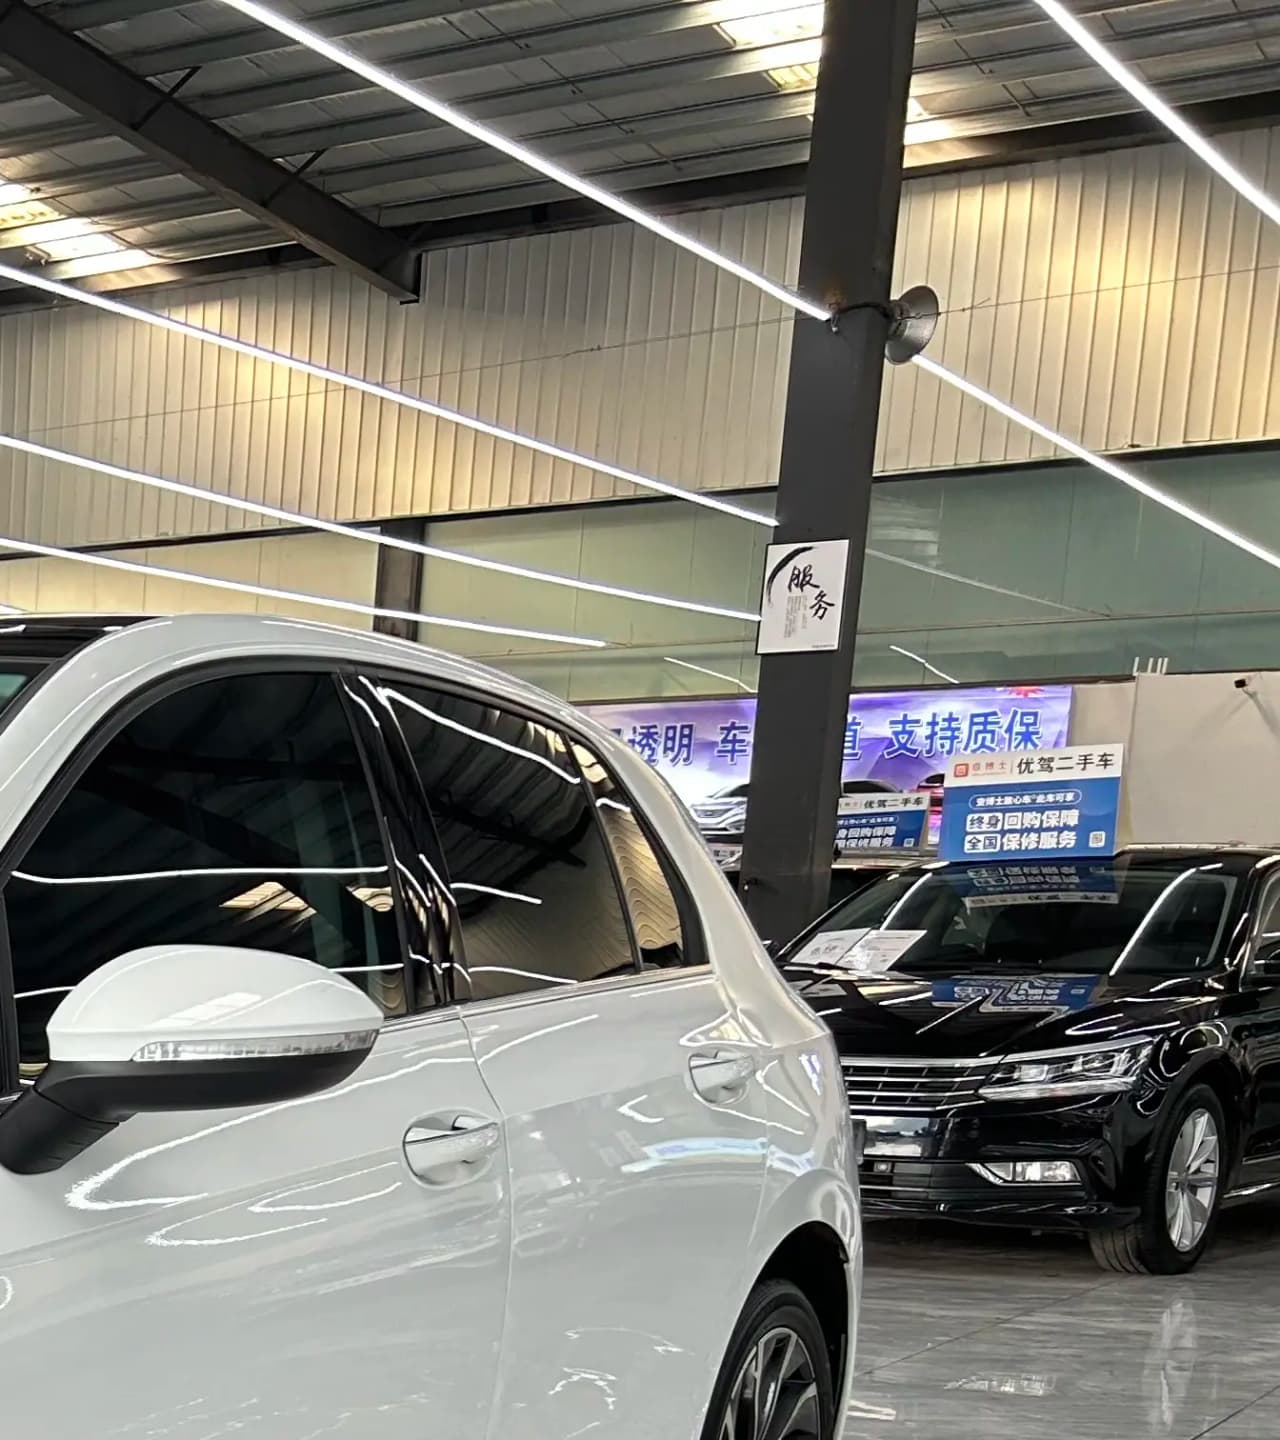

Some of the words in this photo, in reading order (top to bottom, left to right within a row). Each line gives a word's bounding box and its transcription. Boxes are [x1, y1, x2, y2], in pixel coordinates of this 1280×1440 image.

[787, 564, 835, 621] 服务
[609, 723, 694, 765] 透明
[883, 708, 1042, 757] 支持质保
[1017, 752, 1115, 775] 优驾二手车
